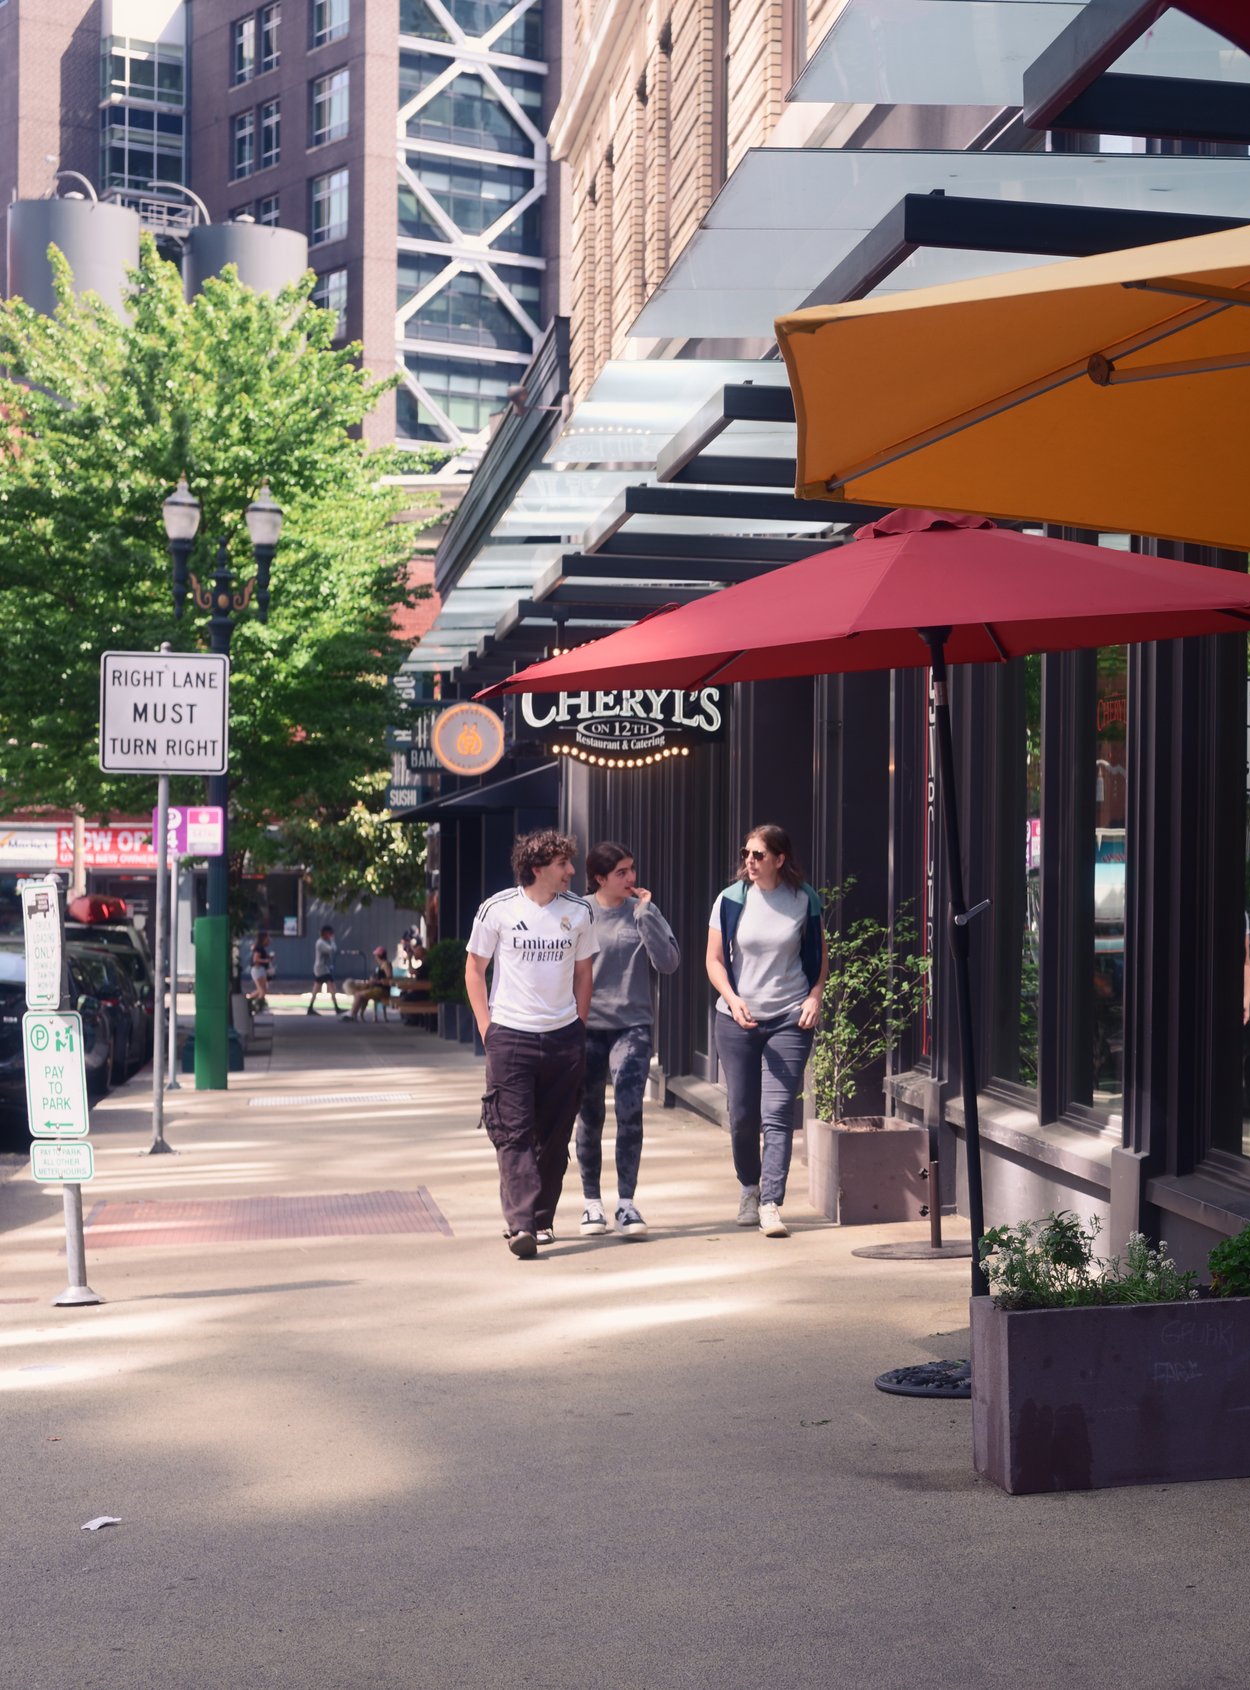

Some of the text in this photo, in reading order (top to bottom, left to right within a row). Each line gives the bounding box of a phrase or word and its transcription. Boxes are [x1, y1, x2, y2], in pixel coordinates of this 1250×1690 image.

[112, 669, 218, 690] RIGHT LANE
[133, 703, 197, 725] MUST
[521, 686, 722, 732] CHERYL'S
[591, 722, 650, 736] ON 12TH
[110, 737, 218, 758] TURN RIGHT
[576, 732, 666, 751] Restaurant & Catering
[389, 788, 417, 807] SUSHI
[60, 854, 94, 864] UNR
[513, 936, 573, 950] Emirates
[34, 946, 55, 959] ONLY
[522, 950, 564, 962] FLY BETTER
[44, 1065, 64, 1079] PAY
[48, 1081, 63, 1094] TO
[42, 1096, 72, 1110] PARK
[40, 1148, 52, 1156] PAY
[62, 1148, 82, 1156] PARK
[43, 1158, 80, 1166] ALL OTHER
[61, 1167, 87, 1176] HOURS
